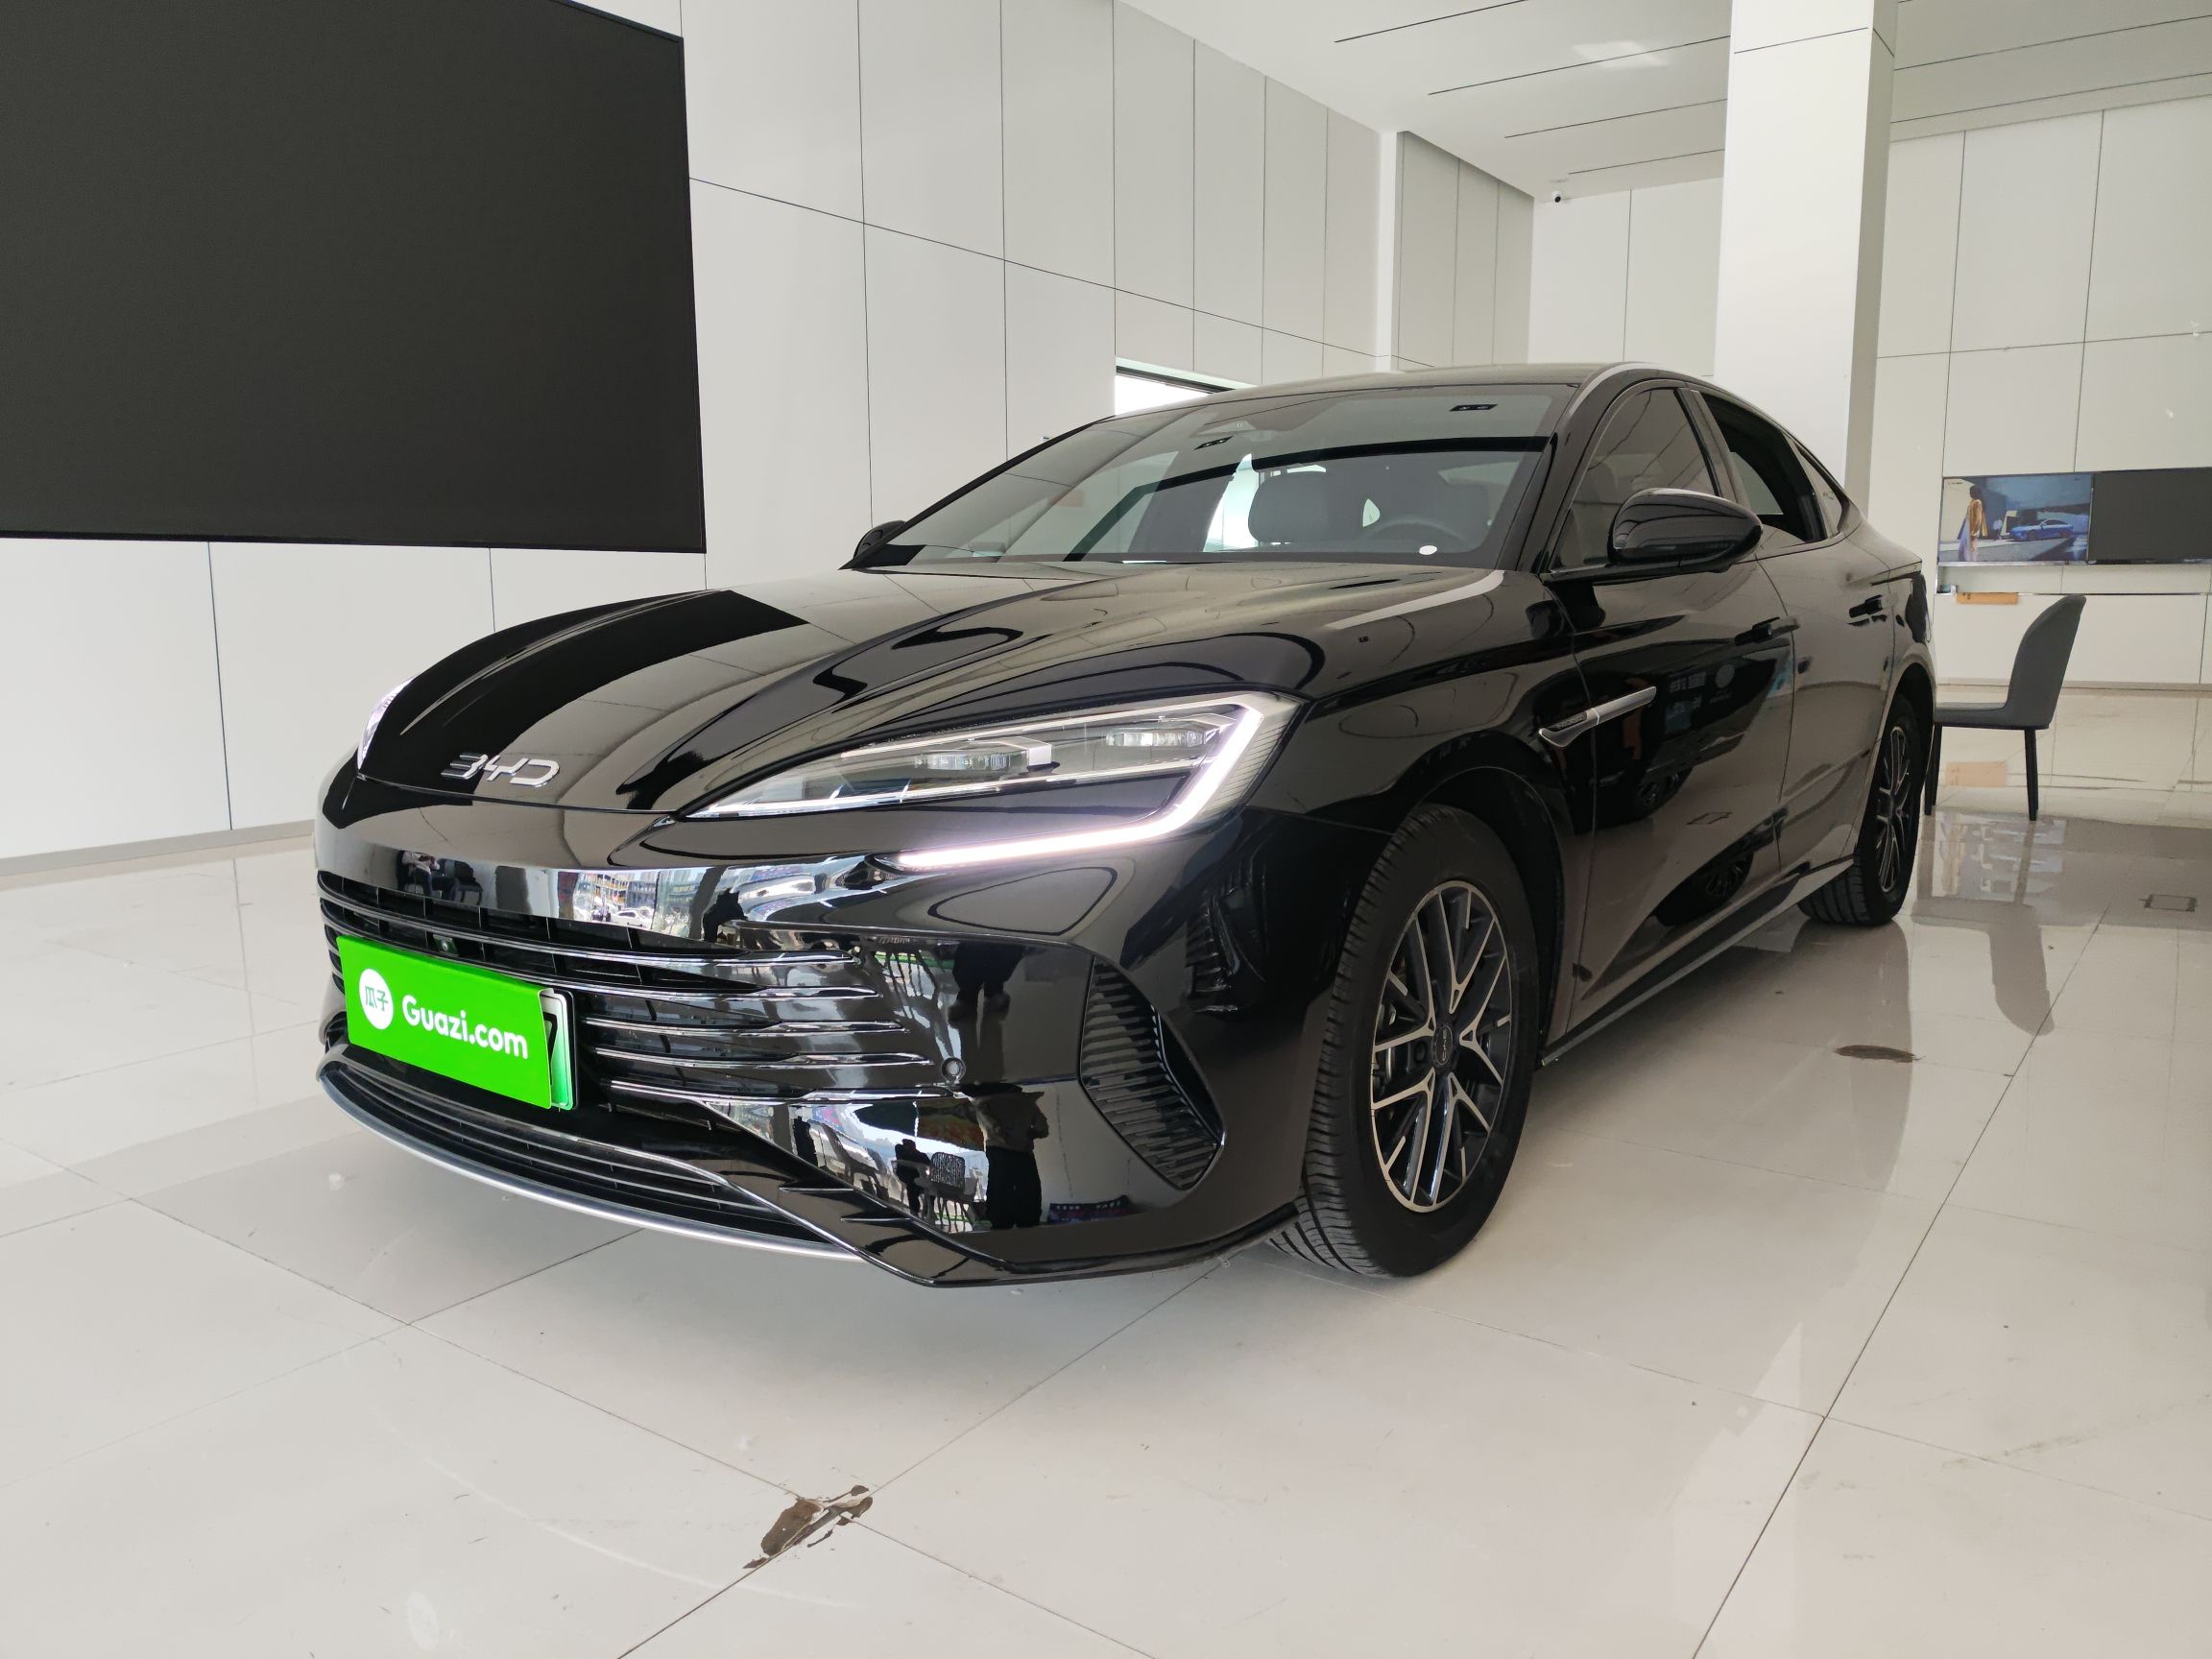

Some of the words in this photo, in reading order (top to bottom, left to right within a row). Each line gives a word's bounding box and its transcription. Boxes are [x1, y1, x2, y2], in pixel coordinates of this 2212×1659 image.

[441, 754, 560, 787] BYD
[364, 985, 389, 1012] 瓜子
[401, 995, 528, 1060] Guazi.com
